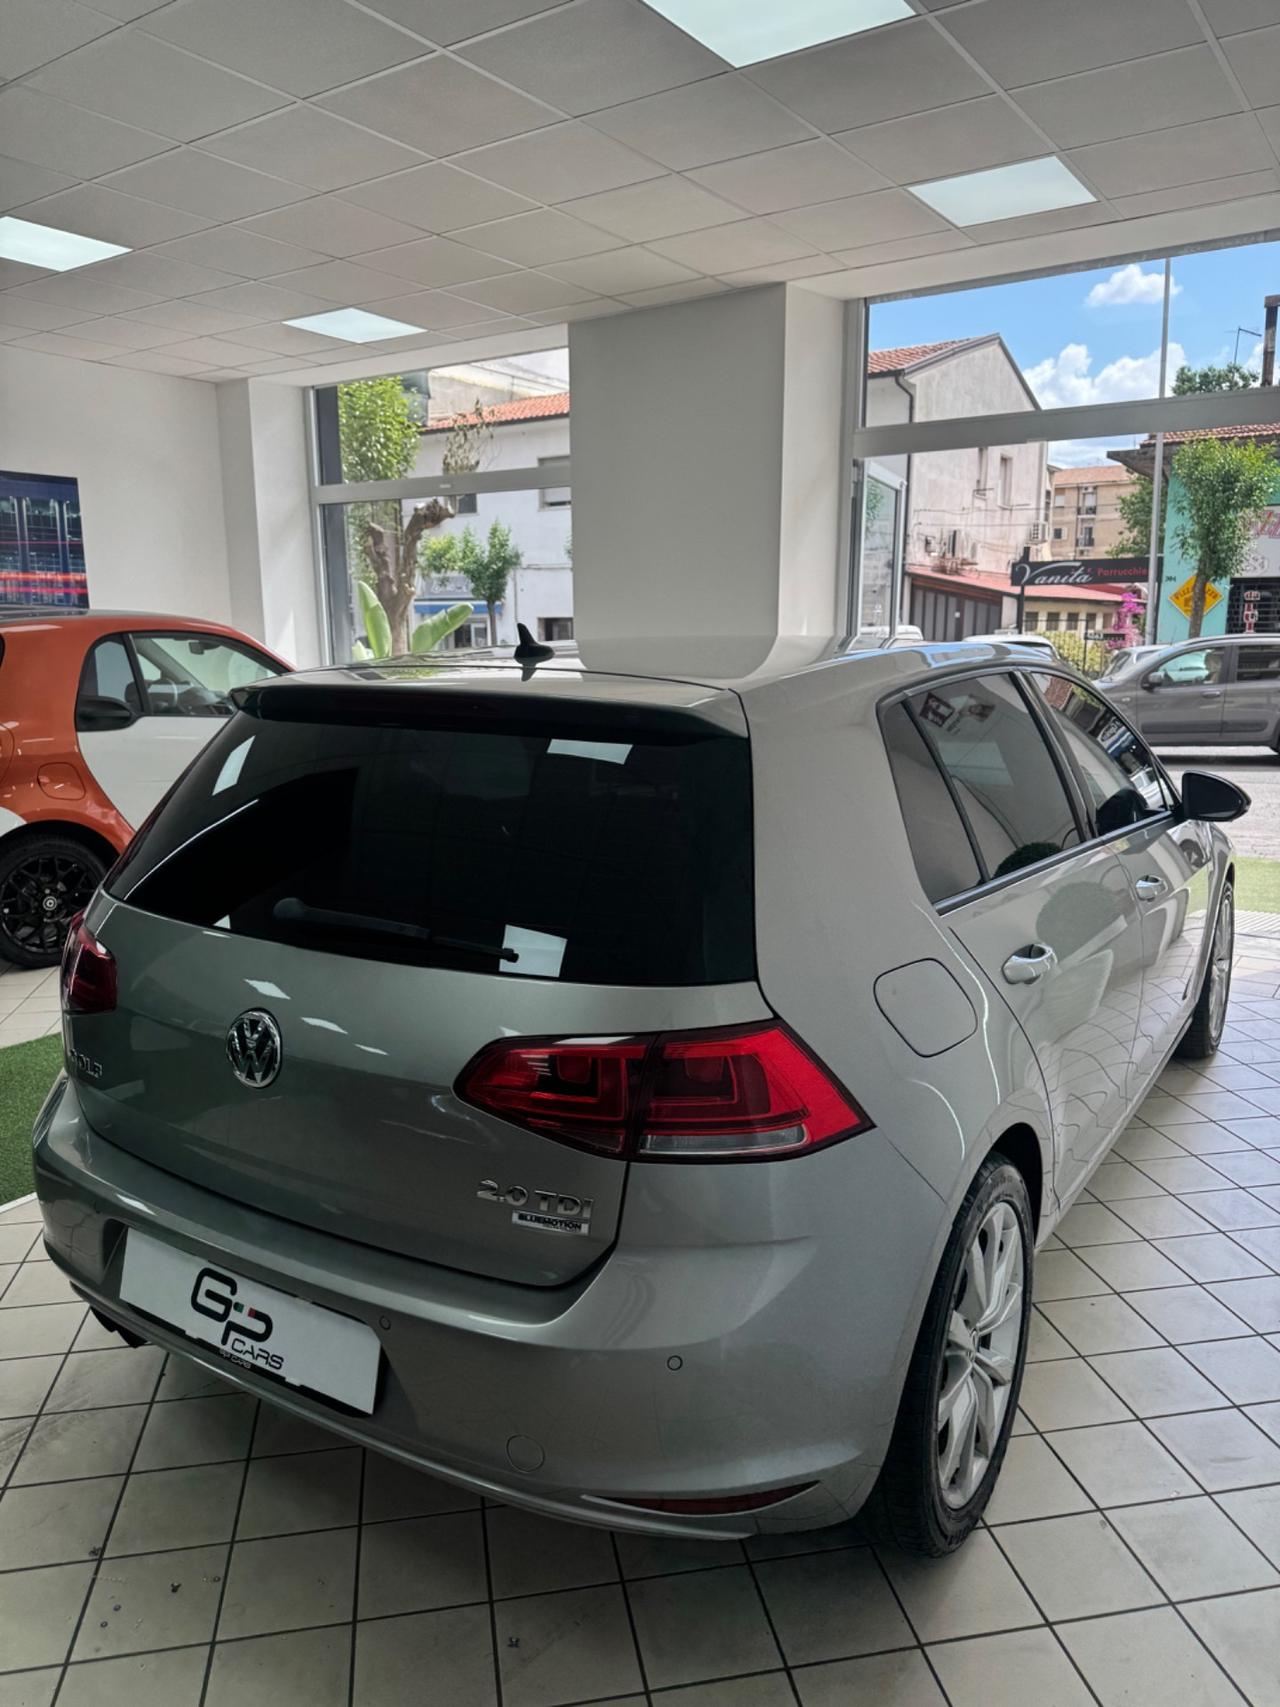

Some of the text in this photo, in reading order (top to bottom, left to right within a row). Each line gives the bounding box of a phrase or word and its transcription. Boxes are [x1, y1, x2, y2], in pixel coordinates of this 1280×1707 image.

[476, 1179, 594, 1218] 2.0 TDI
[230, 1338, 285, 1370] CARS
